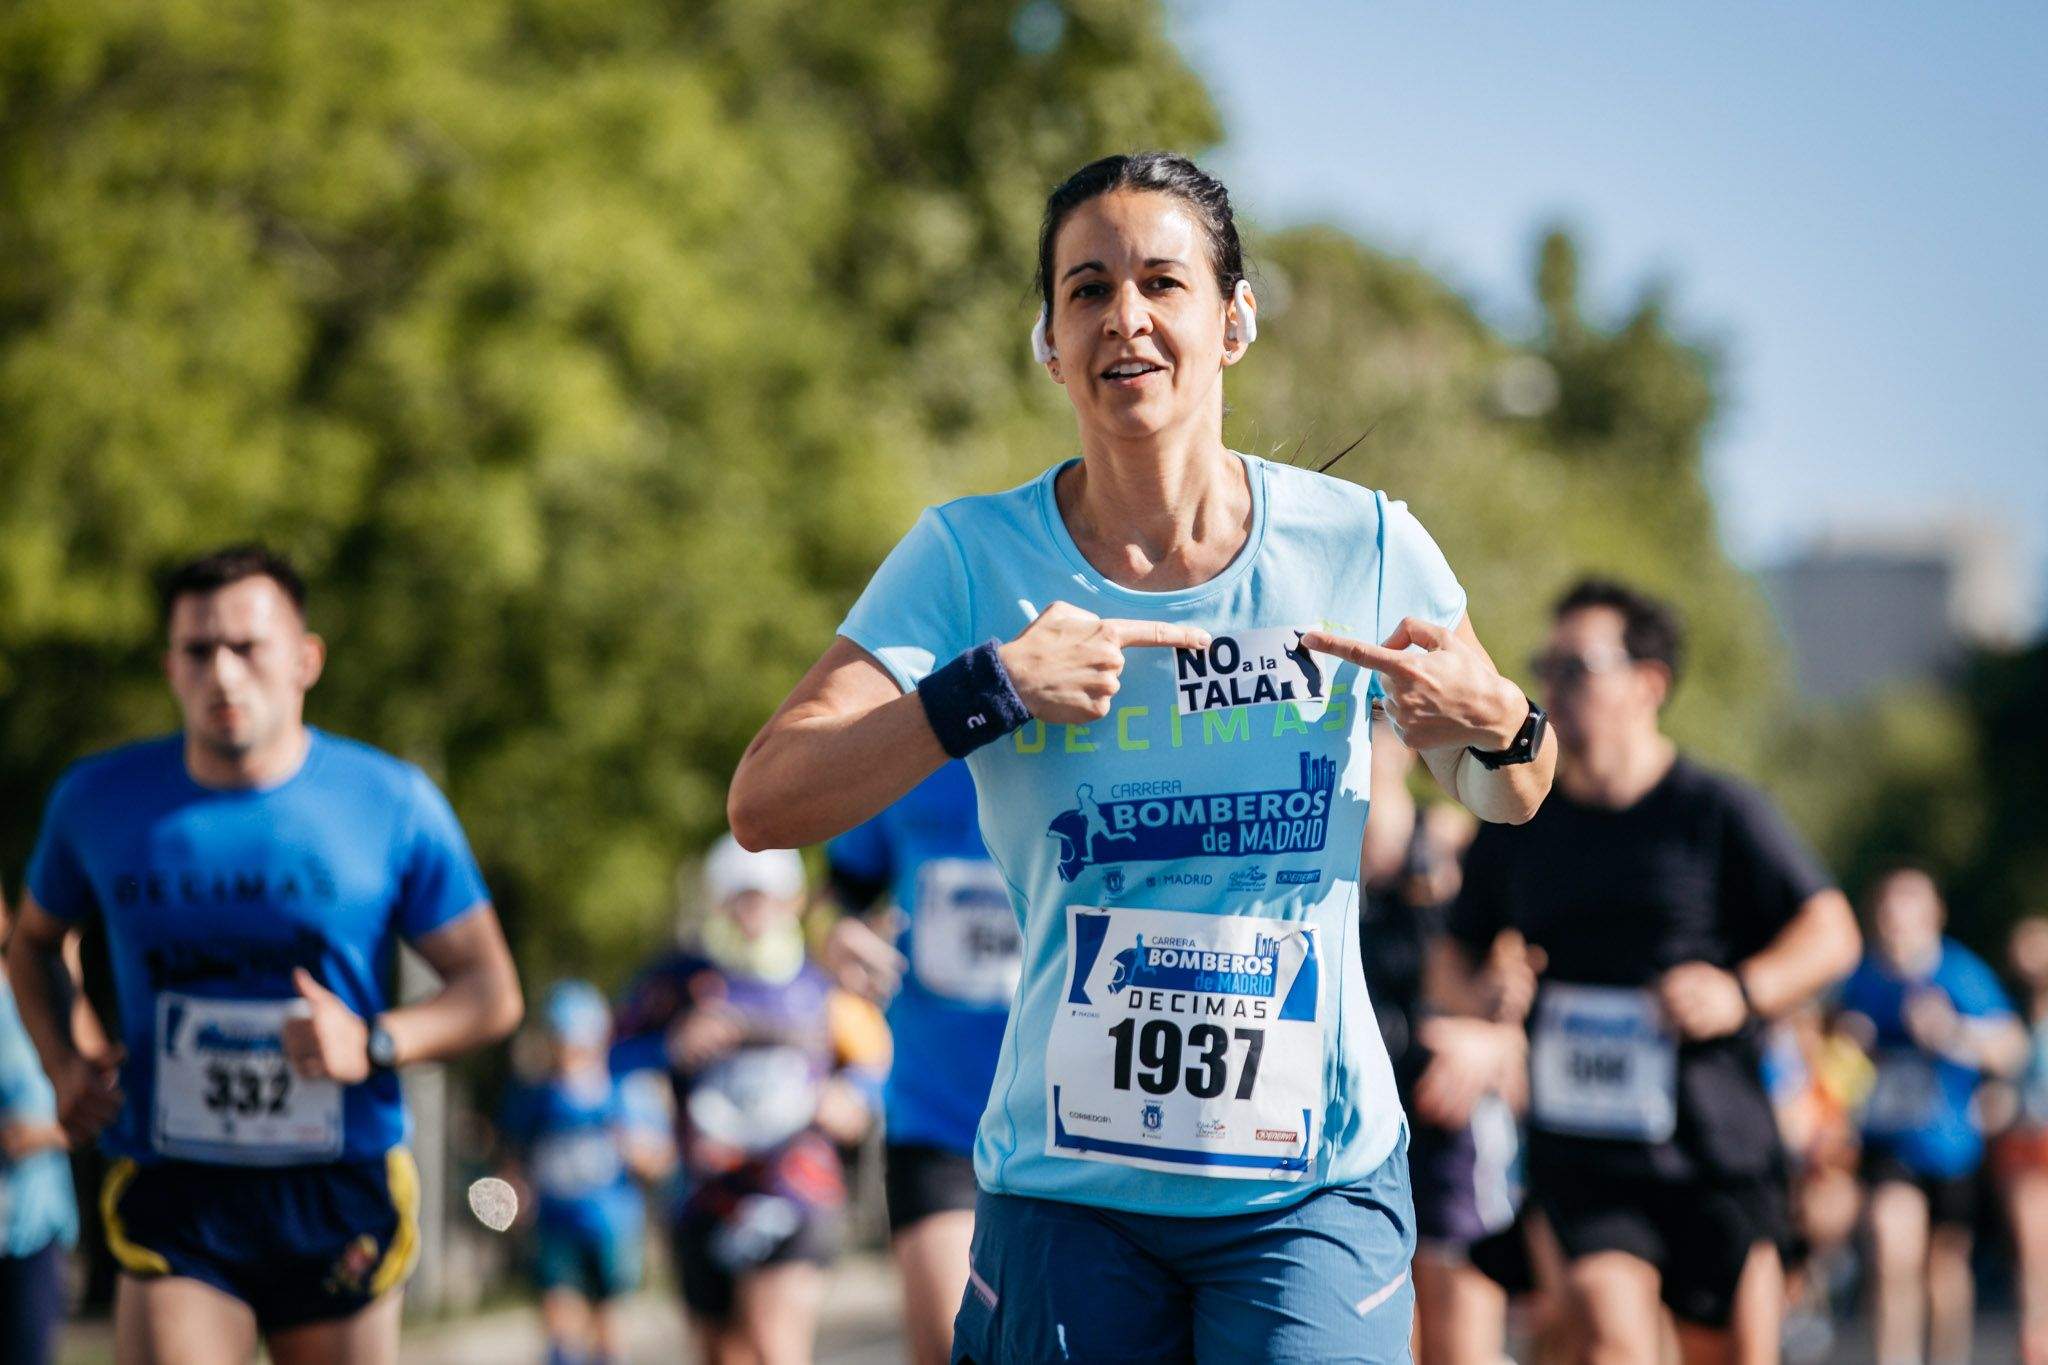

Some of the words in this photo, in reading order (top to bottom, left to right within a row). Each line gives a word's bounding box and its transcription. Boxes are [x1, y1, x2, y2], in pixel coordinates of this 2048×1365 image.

[1175, 636, 1241, 680] NO
[1242, 661, 1254, 673] a
[1260, 655, 1278, 671] la
[1180, 674, 1280, 712] TALA
[1111, 779, 1182, 799] CARRERA
[1112, 789, 1328, 831] BOMBEROS
[1202, 825, 1231, 852] de
[1239, 818, 1325, 853] MADRID
[1163, 873, 1213, 886] MADRID
[1151, 935, 1196, 948] CARRERA
[1149, 948, 1274, 977] BOMBEROS
[1194, 970, 1213, 991] de
[1217, 972, 1272, 996] MADRID
[1128, 989, 1267, 1019] DECIMAS
[1108, 1017, 1265, 1101] 1937
[205, 1062, 291, 1117] 332
